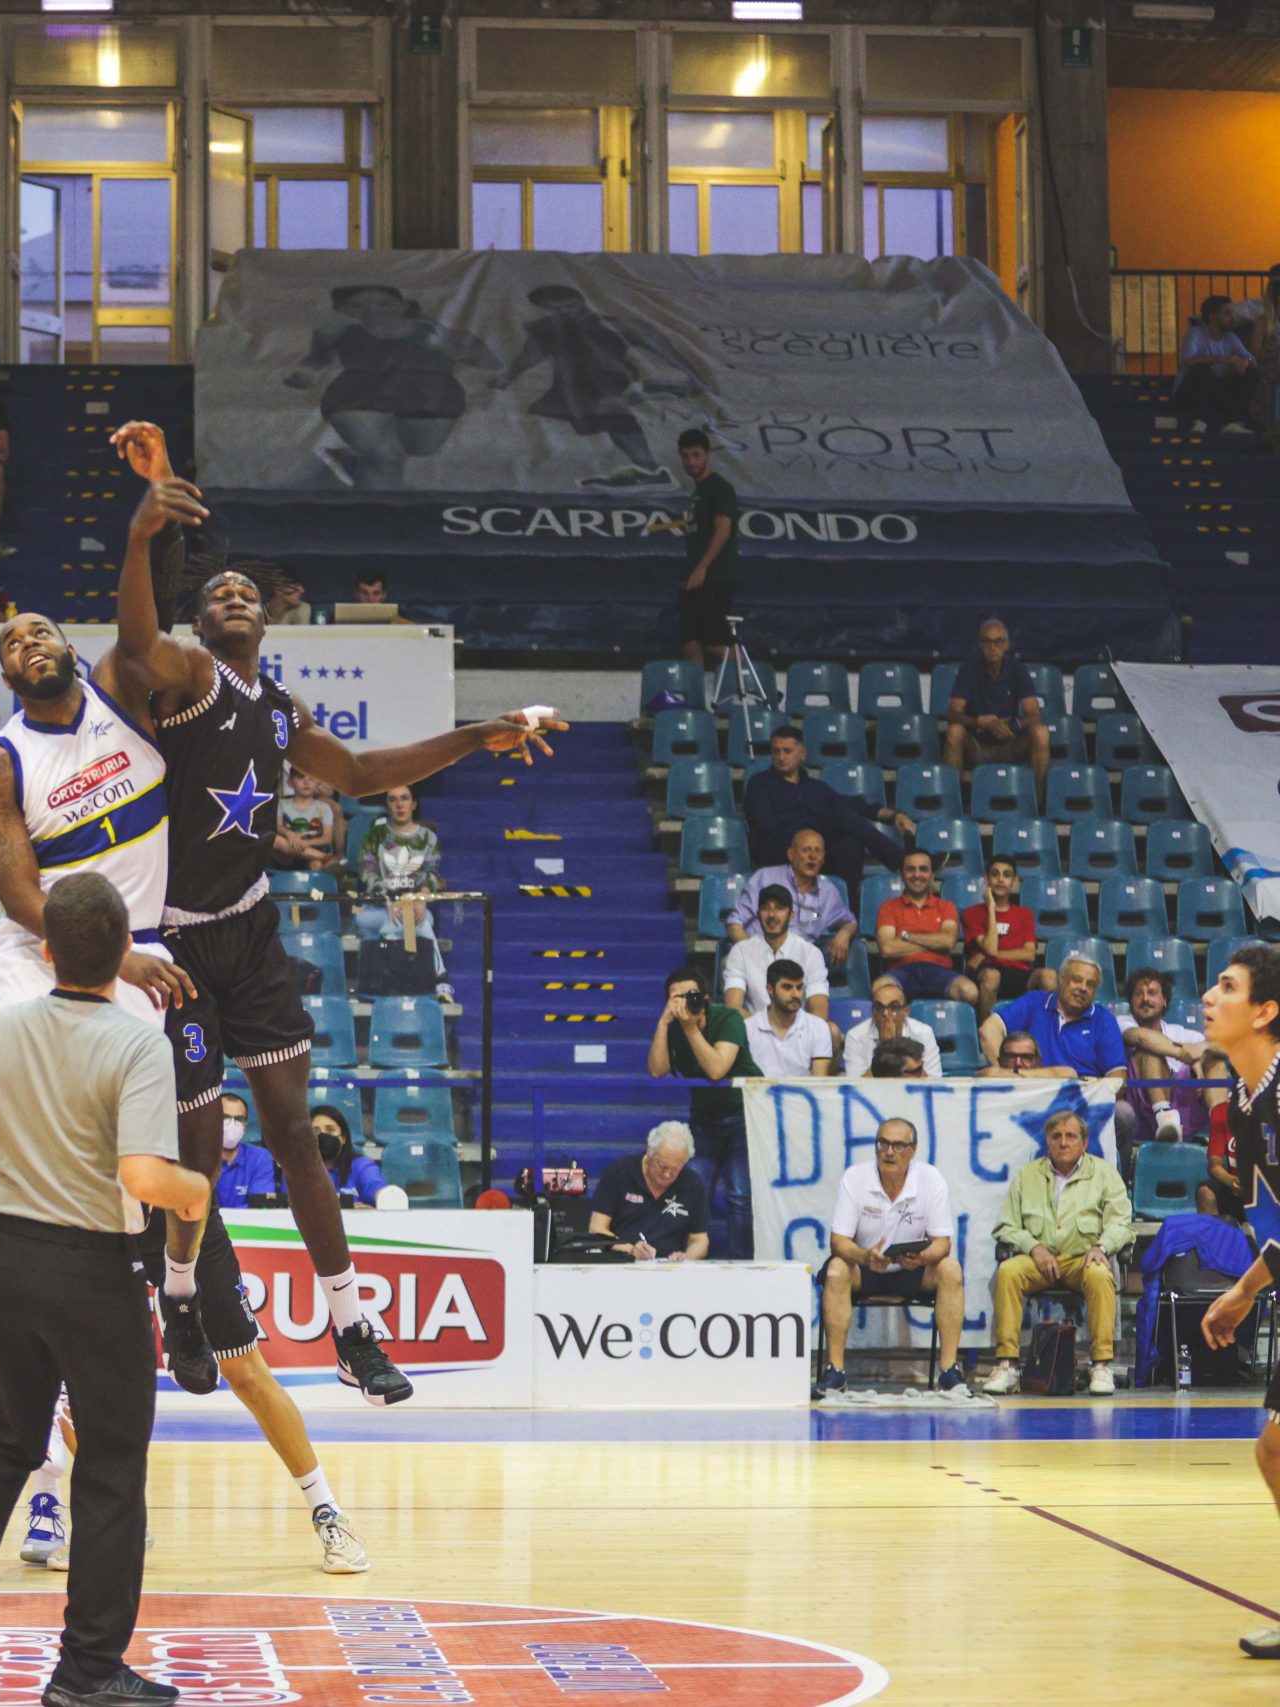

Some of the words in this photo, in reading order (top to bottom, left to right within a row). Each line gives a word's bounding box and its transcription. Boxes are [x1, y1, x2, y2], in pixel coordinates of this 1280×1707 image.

[441, 506, 918, 544] SCARPAONDO
[272, 709, 289, 750] 3
[99, 815, 117, 845] 1
[183, 1023, 207, 1062] 3
